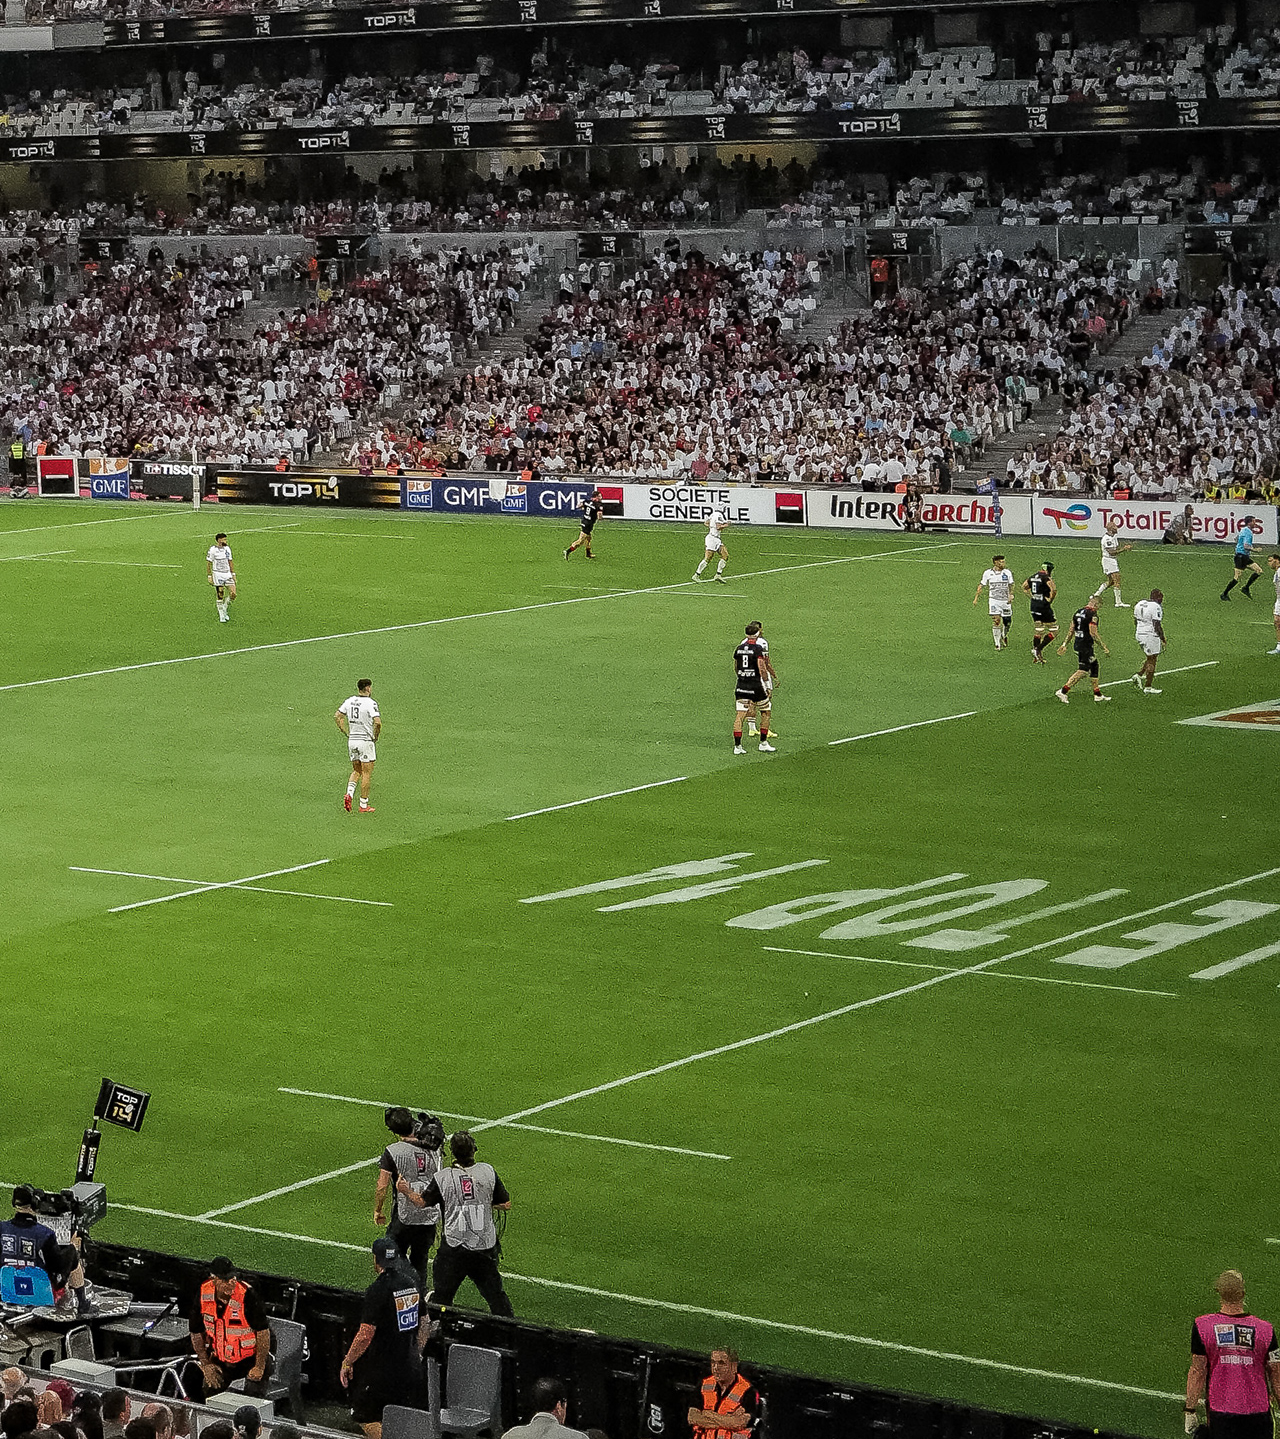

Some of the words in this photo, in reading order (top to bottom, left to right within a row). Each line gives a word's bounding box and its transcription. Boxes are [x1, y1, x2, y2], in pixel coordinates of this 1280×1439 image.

[93, 479, 127, 494] GMF
[409, 494, 430, 505] GMF
[444, 485, 490, 506] GMF
[539, 490, 588, 511] GMF
[649, 487, 730, 504] SOCIETE
[351, 706, 359, 719] 13
[116, 1091, 138, 1103] TOP
[113, 1106, 136, 1123] 14
